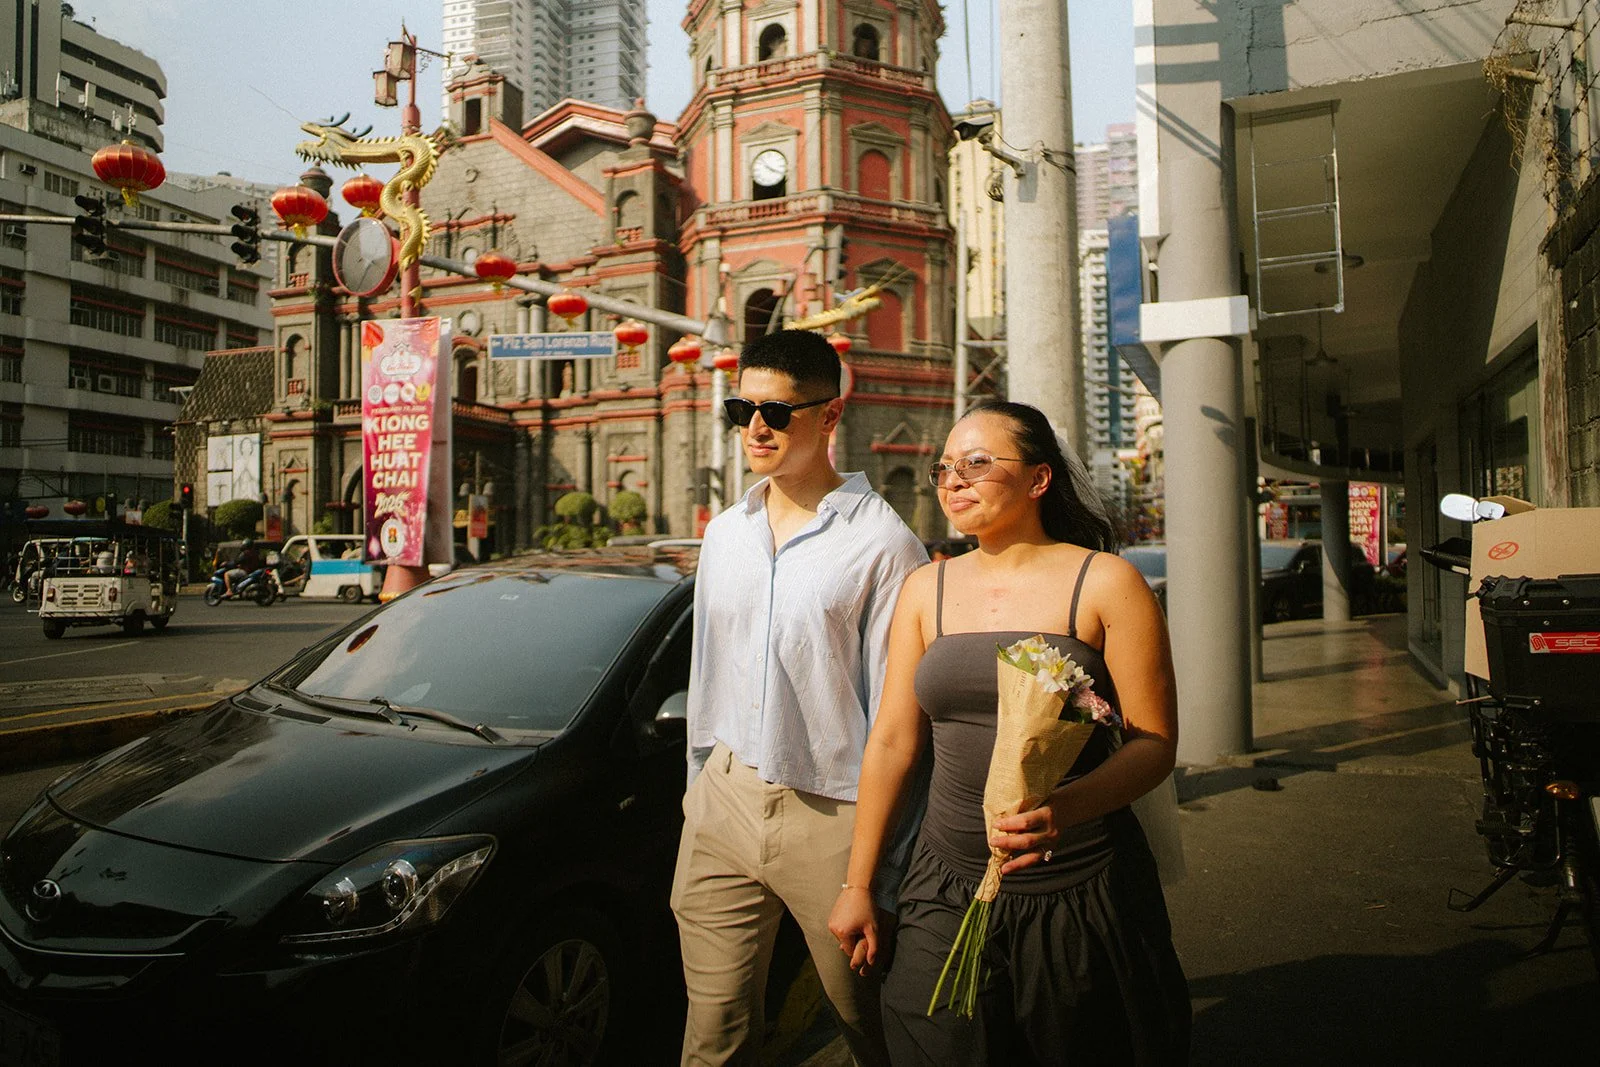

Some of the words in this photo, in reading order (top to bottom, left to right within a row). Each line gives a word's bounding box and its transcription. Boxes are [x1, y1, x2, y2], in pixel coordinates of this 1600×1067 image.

[522, 336, 543, 350] San
[544, 335, 588, 350] Lorenzo
[366, 413, 429, 434] KIONG
[378, 434, 416, 451] HEE
[370, 452, 421, 469] HUAT
[372, 471, 418, 488] CHAI
[375, 491, 408, 517] 2026
